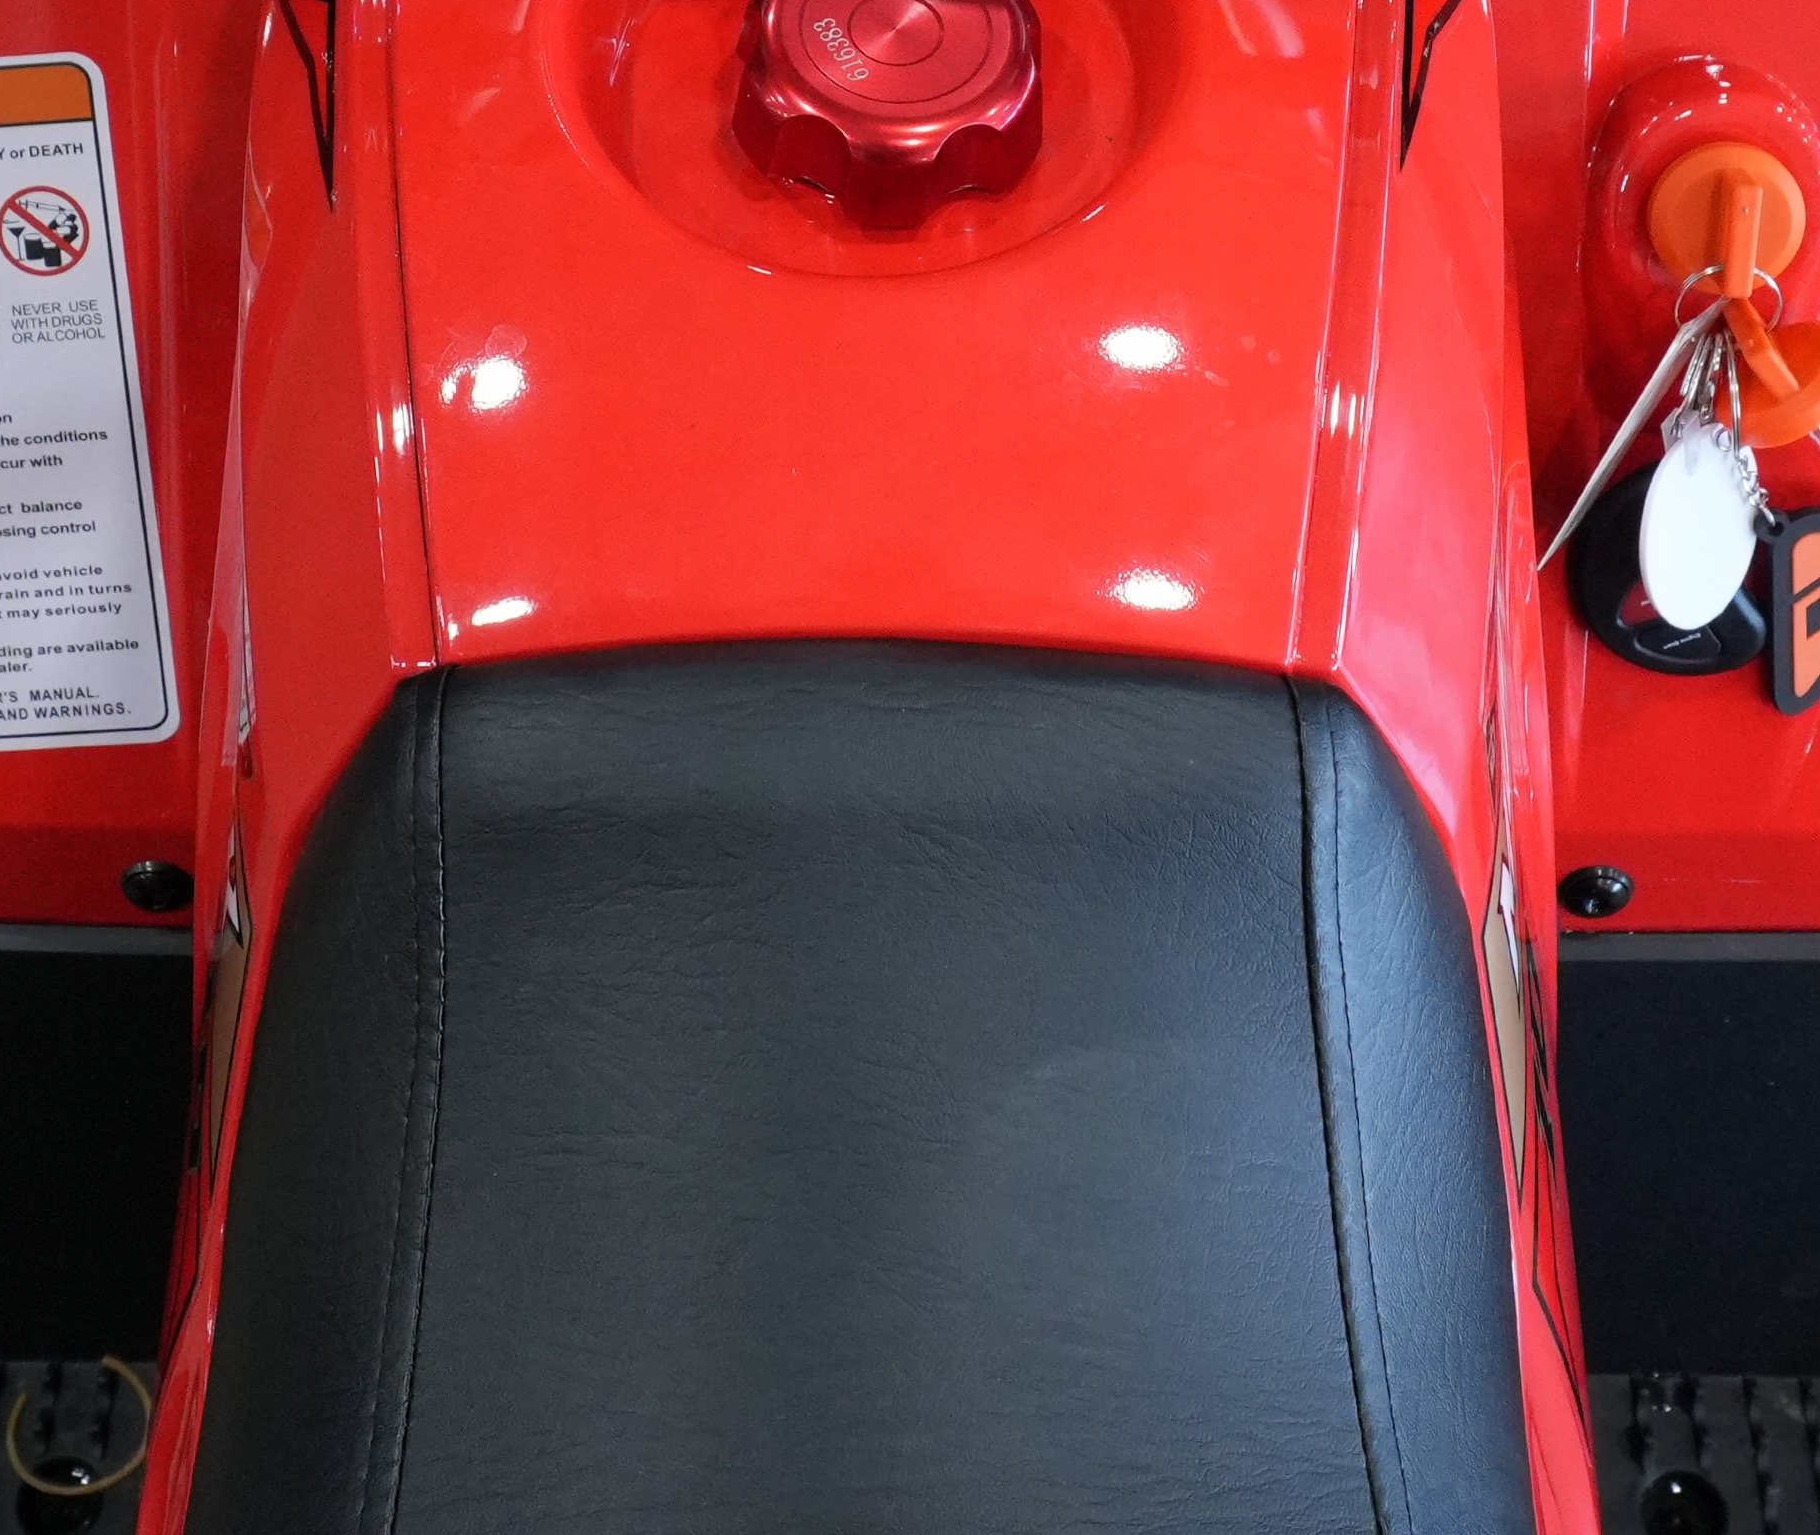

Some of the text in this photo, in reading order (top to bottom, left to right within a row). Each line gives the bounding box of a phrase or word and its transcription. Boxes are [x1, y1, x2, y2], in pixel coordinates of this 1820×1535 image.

[813, 17, 870, 82] 616383
[10, 148, 26, 160] or
[29, 142, 84, 158] DEATH
[11, 300, 98, 316] NEVER USE
[11, 313, 103, 330] WITH DRUGS
[11, 327, 105, 344] OR ALCOHOL
[24, 429, 108, 446] conditions
[29, 454, 63, 467] with
[21, 500, 83, 514] balance
[41, 520, 96, 535] control
[43, 565, 103, 579] vehicle
[34, 586, 64, 598] and
[69, 585, 84, 596] in
[89, 583, 132, 595] turns
[7, 608, 40, 619] may
[45, 602, 122, 617] seriously
[37, 644, 62, 655] are
[67, 639, 139, 653] available
[29, 686, 99, 701] MANUAL.
[34, 702, 131, 719] WARNINGS.
